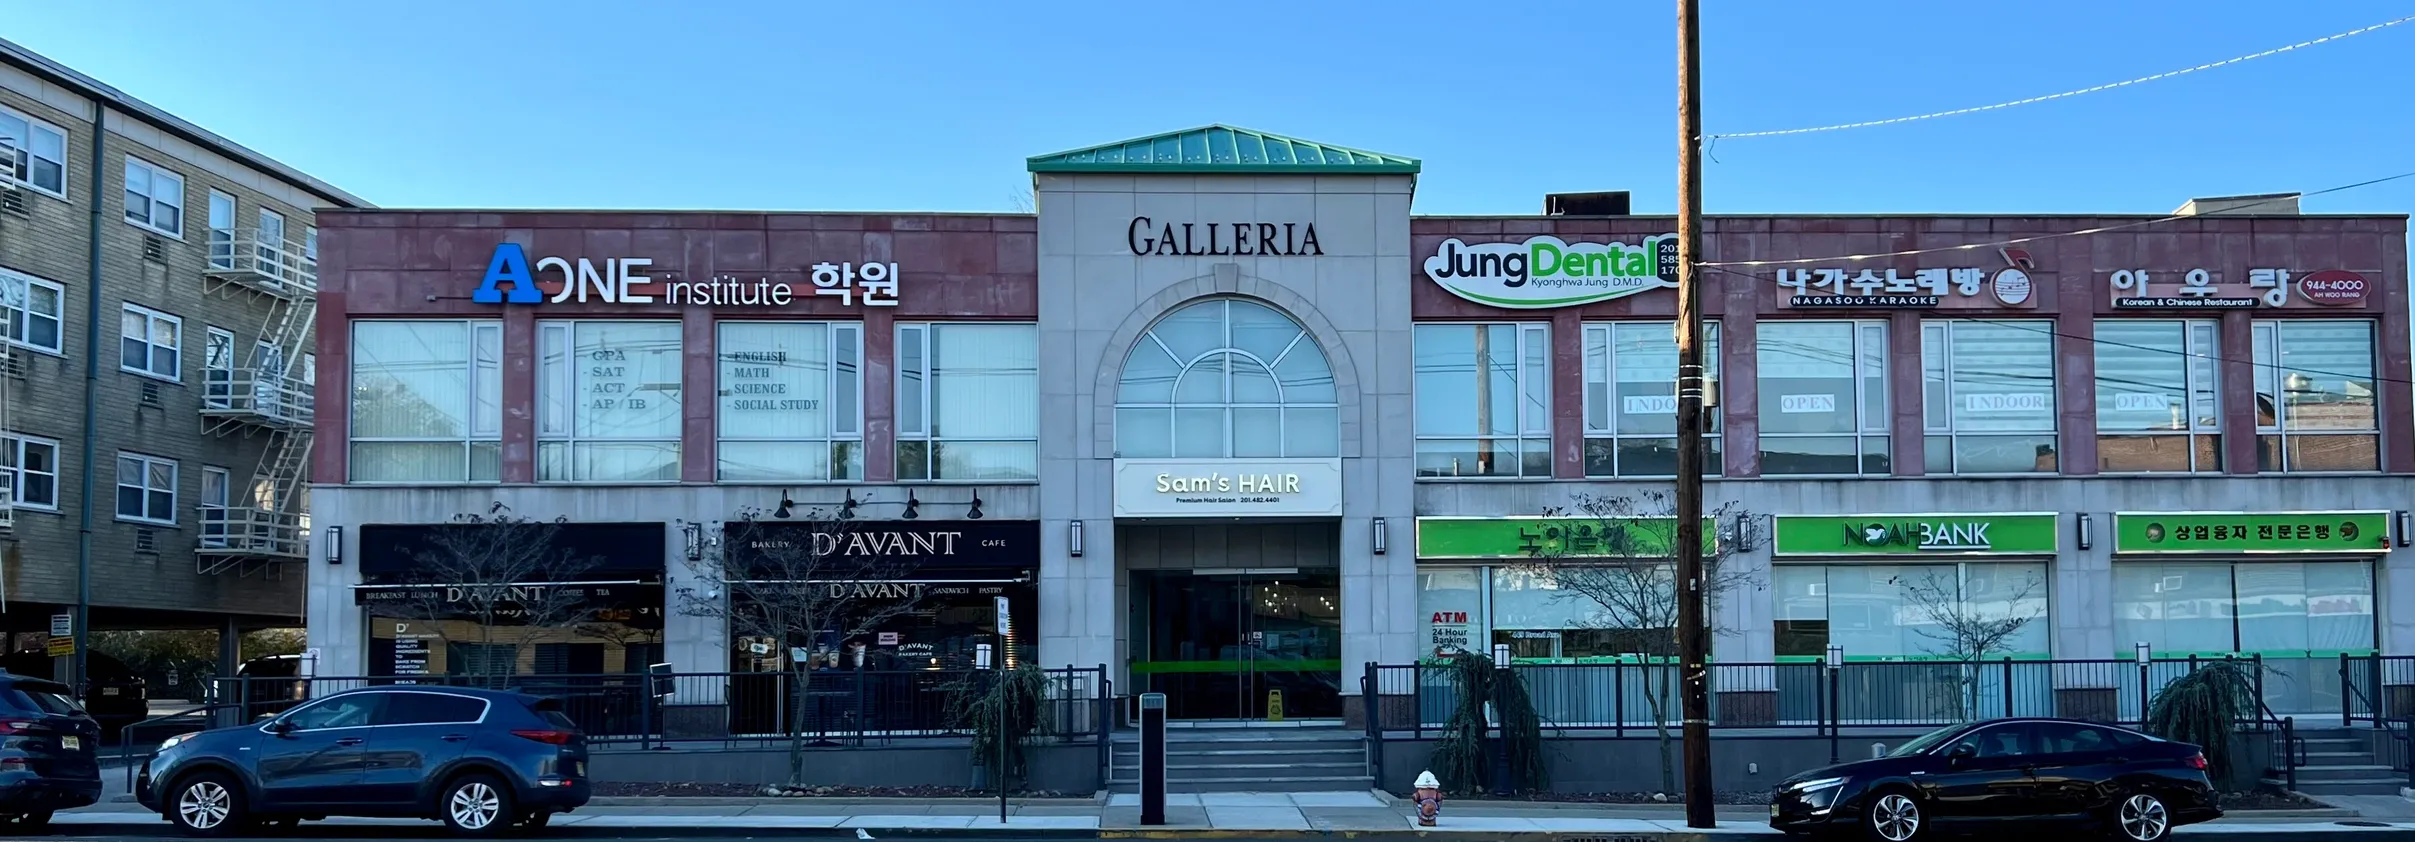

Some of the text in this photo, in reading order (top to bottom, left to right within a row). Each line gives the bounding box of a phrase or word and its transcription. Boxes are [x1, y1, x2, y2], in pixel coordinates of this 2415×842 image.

[1128, 216, 1325, 256] GALLERIA
[810, 260, 900, 307] 학원
[1531, 277, 1644, 289] Kyonghwa Jung D.M.D.
[1775, 267, 1985, 297] 나가수노래방
[2306, 280, 2364, 290] 944-4000
[665, 274, 792, 306] institute
[1792, 296, 1937, 305] NAGASOO KARAOKE
[2122, 298, 2155, 307] Korean
[2166, 298, 2202, 307] Chinese
[2204, 298, 2253, 307] Restaurant
[592, 350, 626, 361] GPA
[734, 351, 787, 362] ENGLISH
[592, 366, 625, 377] SAT
[734, 368, 770, 378] MATH
[592, 383, 626, 393] ACT
[734, 384, 787, 394] SCIENCE
[734, 400, 819, 410] SOCIAL STUDY
[1782, 396, 1834, 410] OPEN
[1969, 395, 2044, 409] INDOOR
[2116, 395, 2167, 408] OPEN
[1155, 472, 1300, 493] Sam's HAIR
[2174, 525, 2330, 540] 상업융자 전문은행
[751, 540, 789, 549] BAKERY
[810, 531, 962, 557] D'AVANT
[981, 539, 1006, 547] CAFE
[366, 591, 438, 600] BREAKFAST LUNCH
[596, 588, 610, 596] TEA
[1432, 612, 1467, 623] ATM
[1432, 628, 1468, 636] 24 Hour
[1432, 636, 1468, 646] Banking
